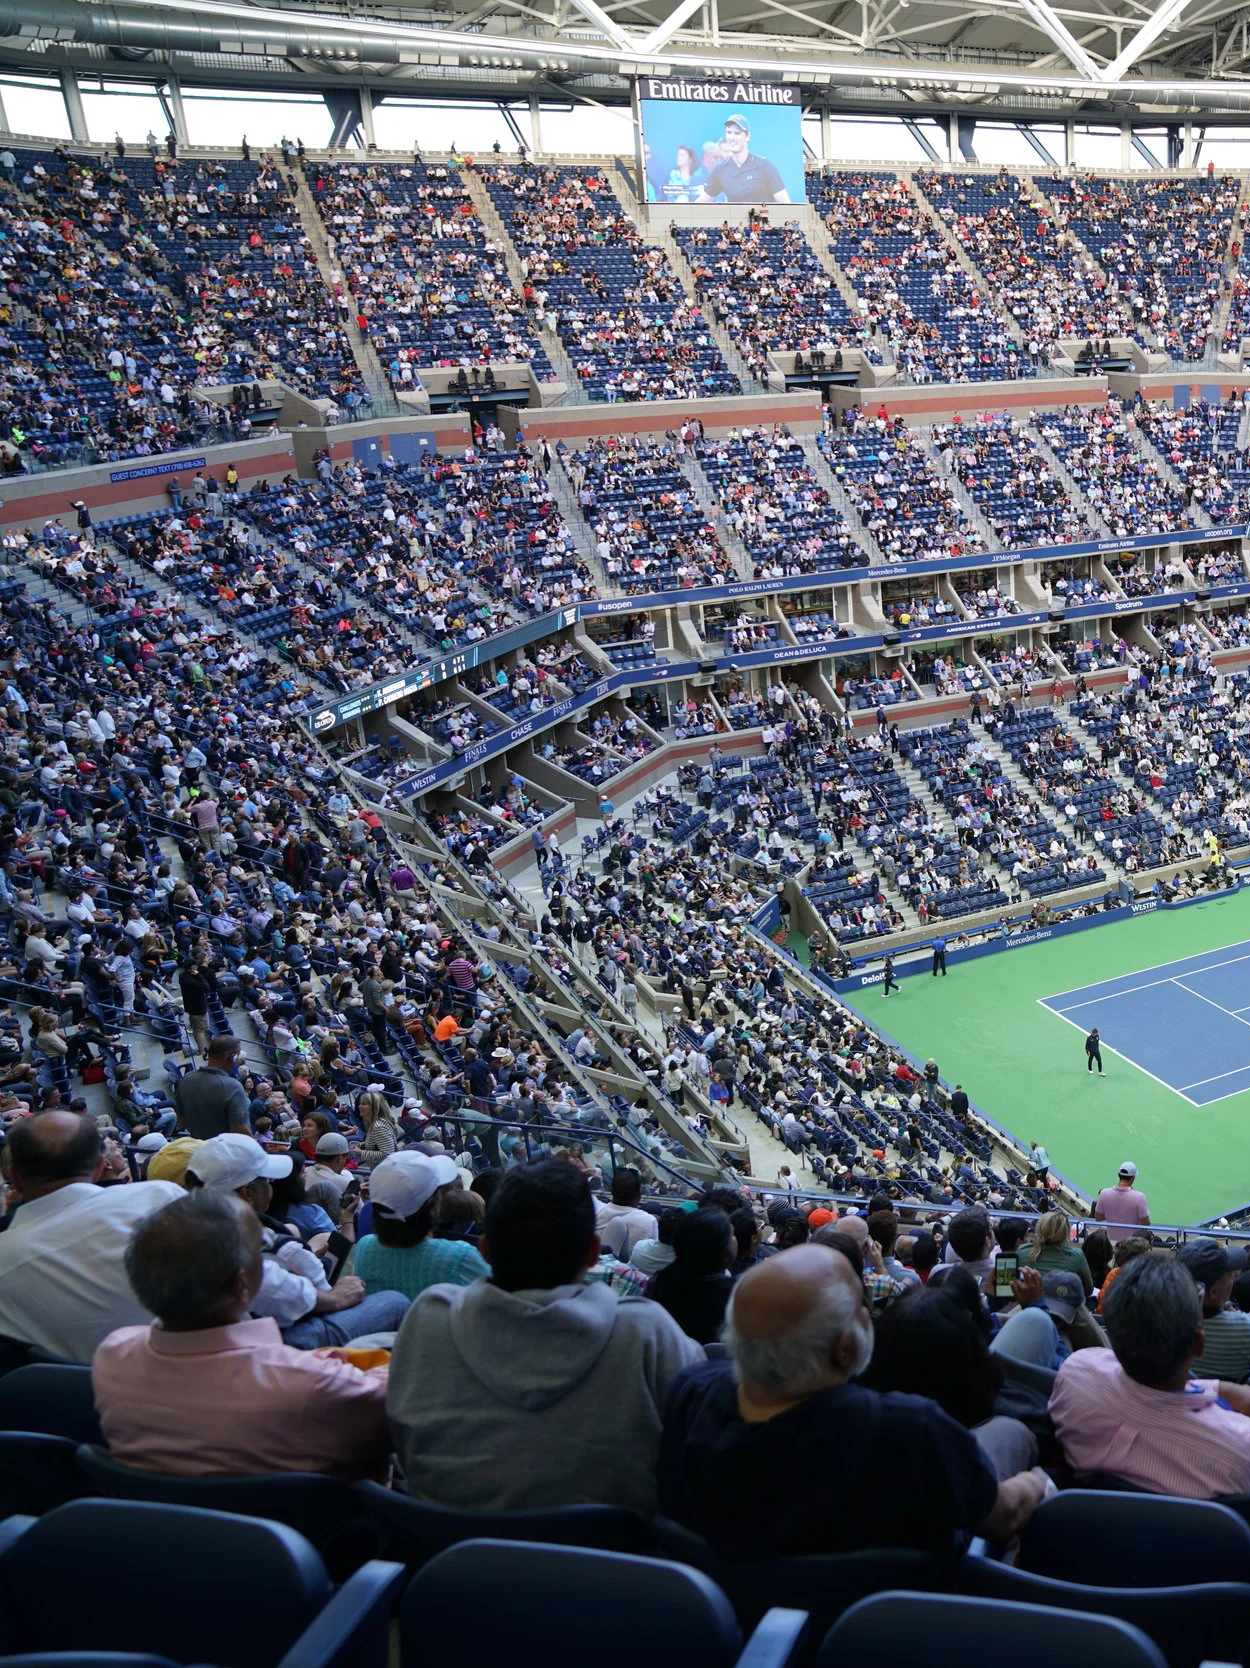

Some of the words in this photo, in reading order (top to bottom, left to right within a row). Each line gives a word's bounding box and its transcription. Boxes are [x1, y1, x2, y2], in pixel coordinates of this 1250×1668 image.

[648, 80, 729, 101] Emirates
[734, 84, 793, 104] Airline
[111, 472, 129, 481] GUEST
[130, 467, 158, 478] CONCERN?
[158, 464, 171, 473] TEXT
[1205, 528, 1233, 538] usopen.org
[1098, 541, 1118, 550] Emirates
[1119, 539, 1135, 548] Airline
[868, 566, 907, 577] Mercedes-Benz
[761, 582, 784, 590] LAUREN
[598, 600, 632, 612] #usopen
[1115, 600, 1143, 612] Spectrum
[946, 625, 973, 633] AMERICAN
[973, 621, 1001, 630] EXPRESS
[596, 681, 609, 698] IBM
[553, 701, 572, 717] FINALS
[511, 722, 533, 740] CHASE
[465, 744, 487, 763] FINALS
[411, 773, 437, 791] WESTIN
[1131, 900, 1157, 912] WESTIN
[1006, 930, 1052, 948] Mercedes-Benz
